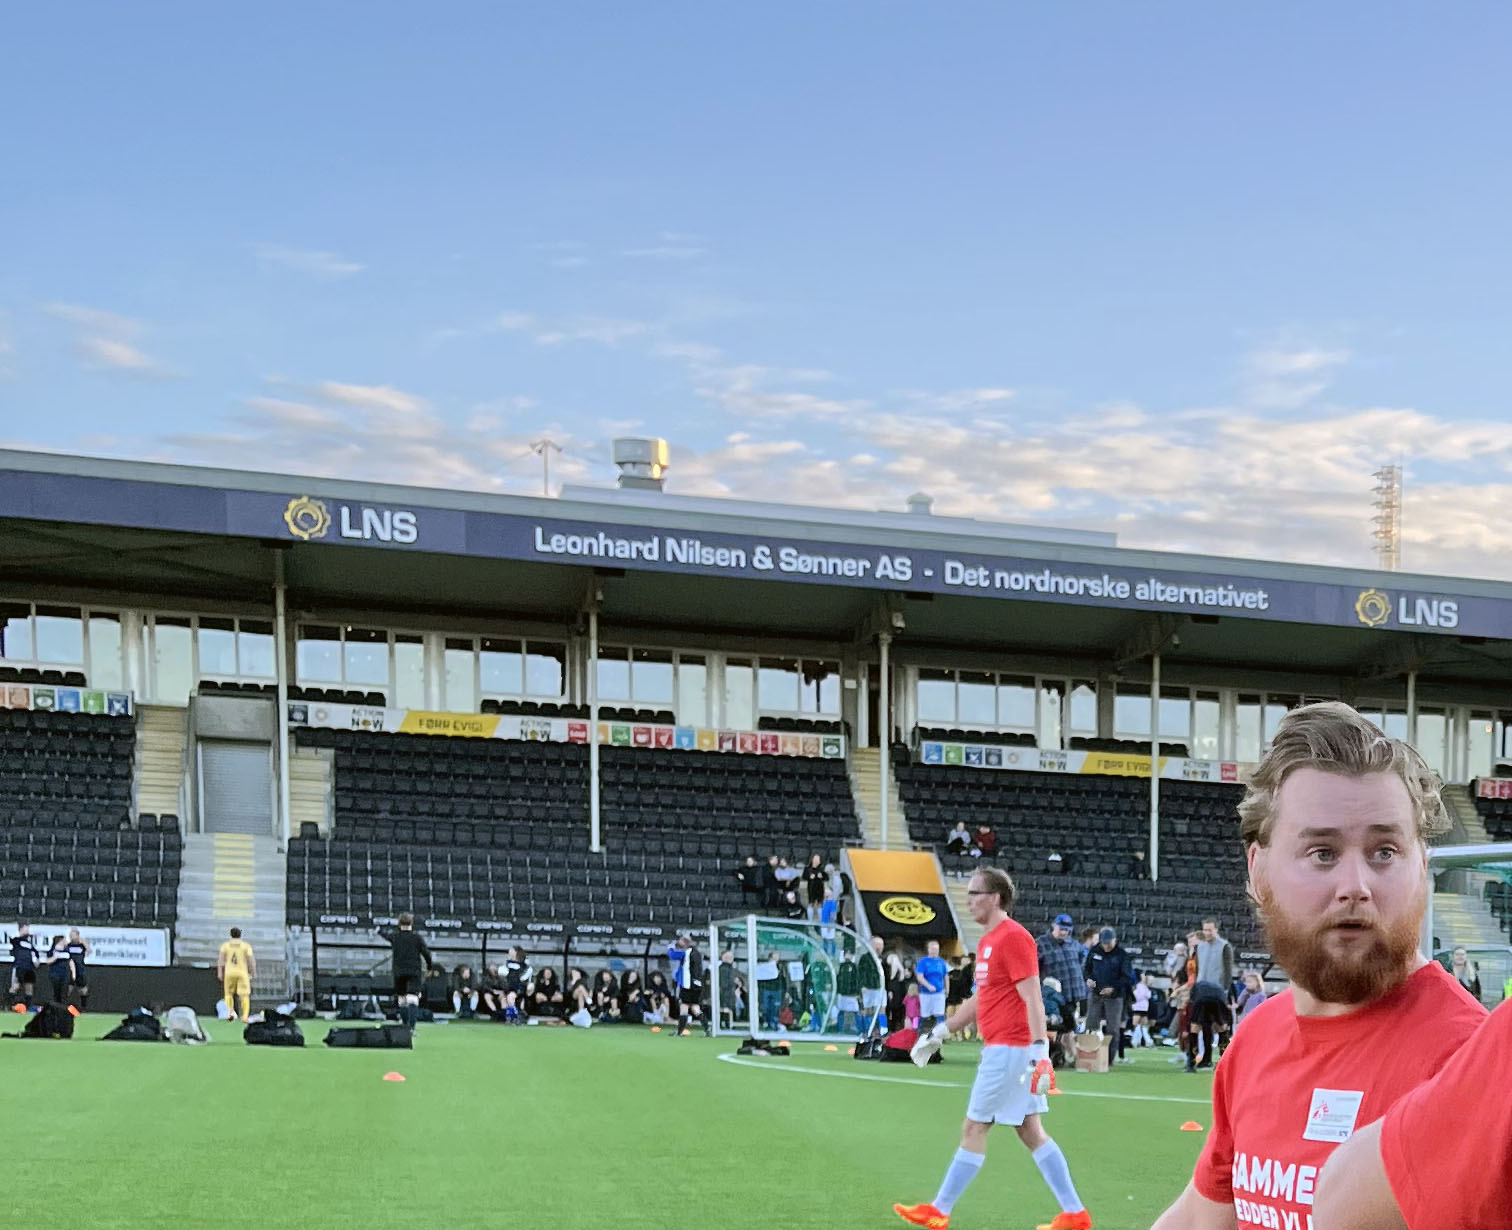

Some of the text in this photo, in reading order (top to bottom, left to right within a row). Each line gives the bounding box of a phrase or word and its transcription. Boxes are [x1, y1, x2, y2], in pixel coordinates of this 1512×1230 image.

[341, 506, 418, 543] LNS
[534, 526, 658, 562] Leonhard
[665, 537, 746, 569] Nilsen
[752, 544, 774, 571] &
[779, 546, 871, 577] Sønner
[875, 555, 912, 582] AS
[944, 560, 991, 588] Det
[994, 569, 1130, 600] nordnorske
[1134, 583, 1269, 611] alternativet
[1399, 597, 1458, 629] LNS
[1232, 1152, 1317, 1205] AMME
[1234, 1198, 1280, 1230] EDDER
